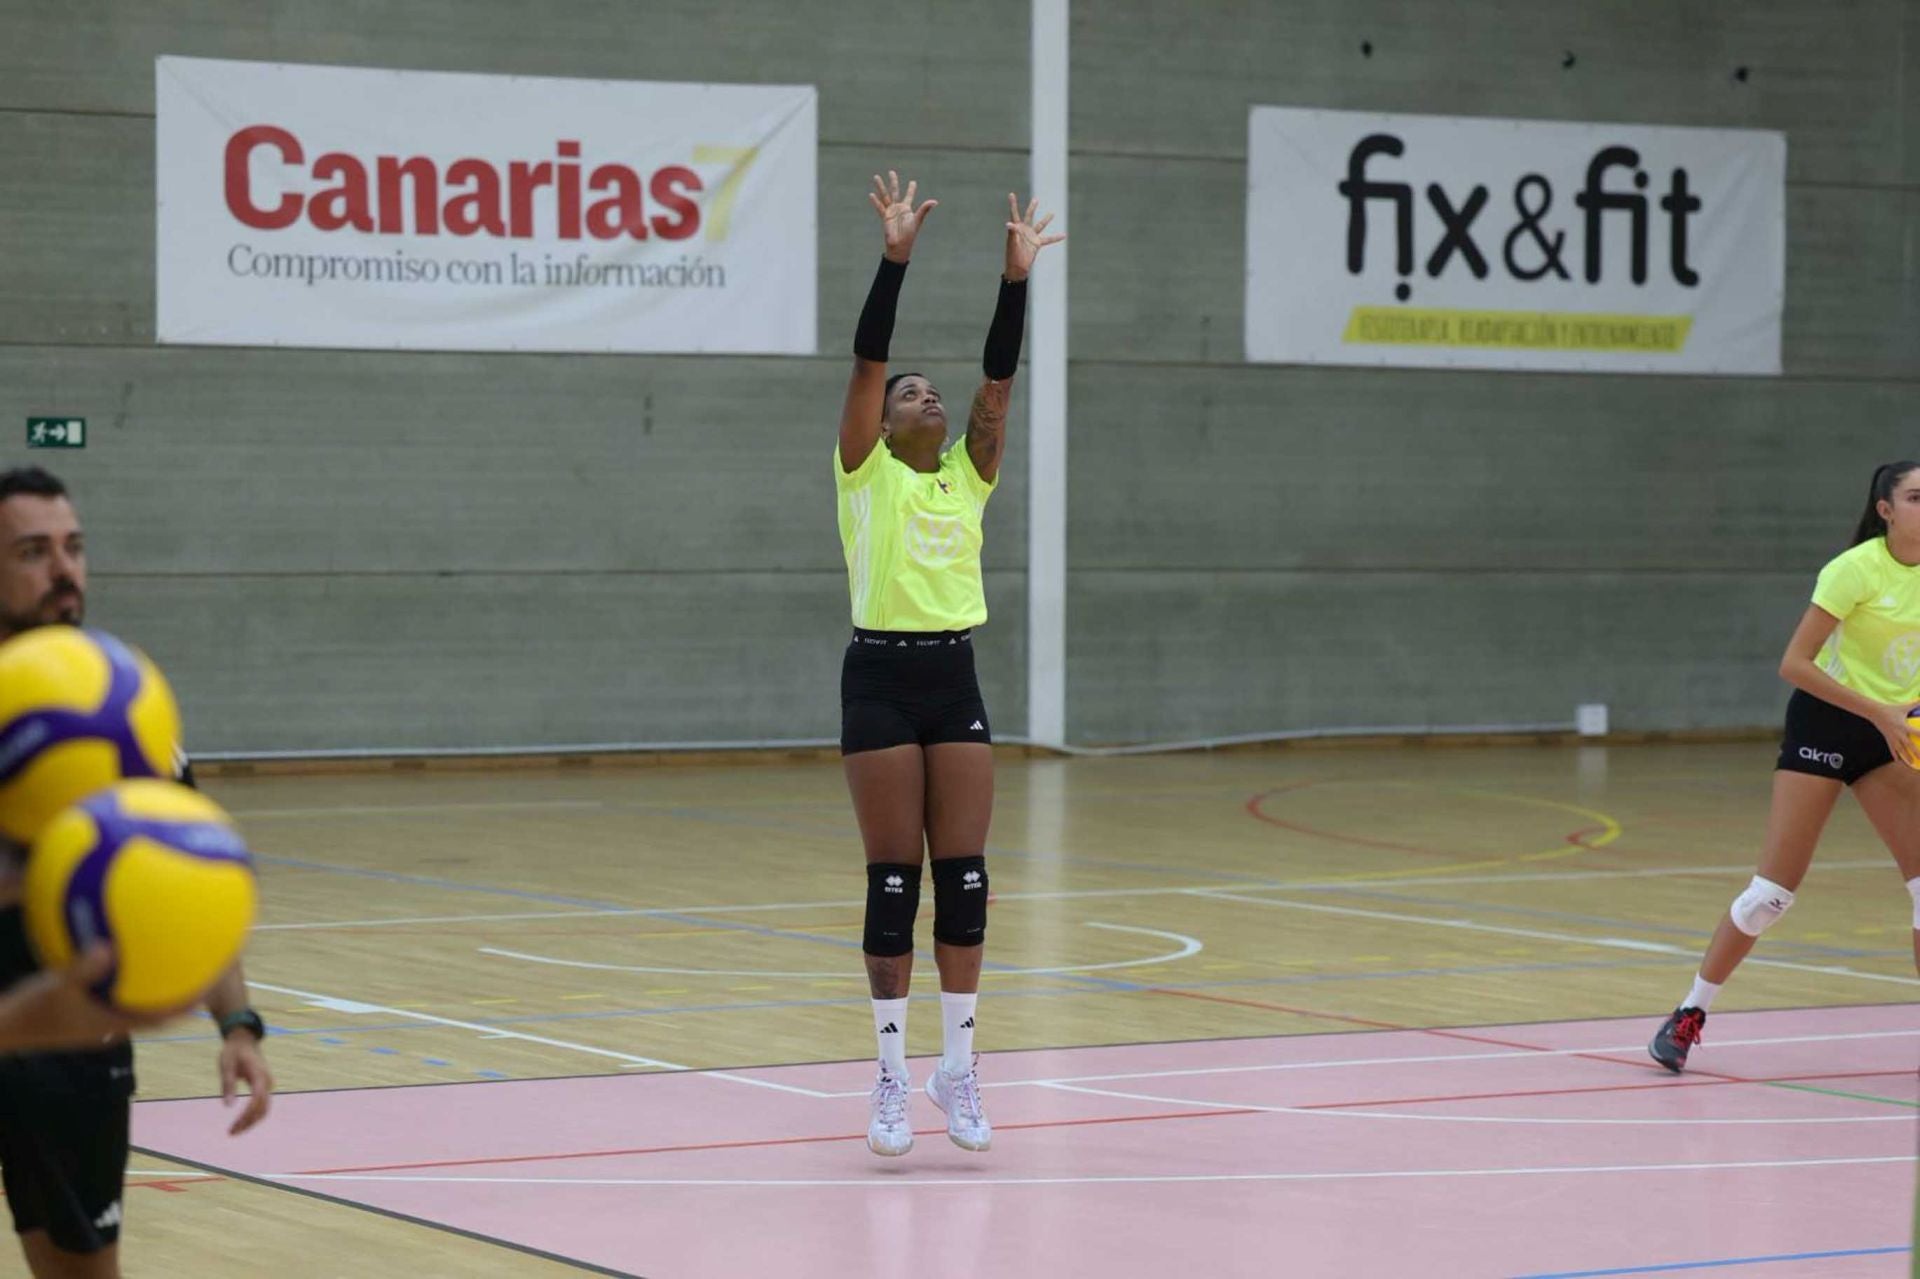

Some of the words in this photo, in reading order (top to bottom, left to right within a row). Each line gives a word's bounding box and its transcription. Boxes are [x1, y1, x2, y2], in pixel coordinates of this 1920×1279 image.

[223, 124, 759, 242] Canarias7
[227, 243, 440, 286] Compromiso
[446, 258, 503, 285] con
[510, 252, 537, 285] la
[544, 253, 727, 288] información
